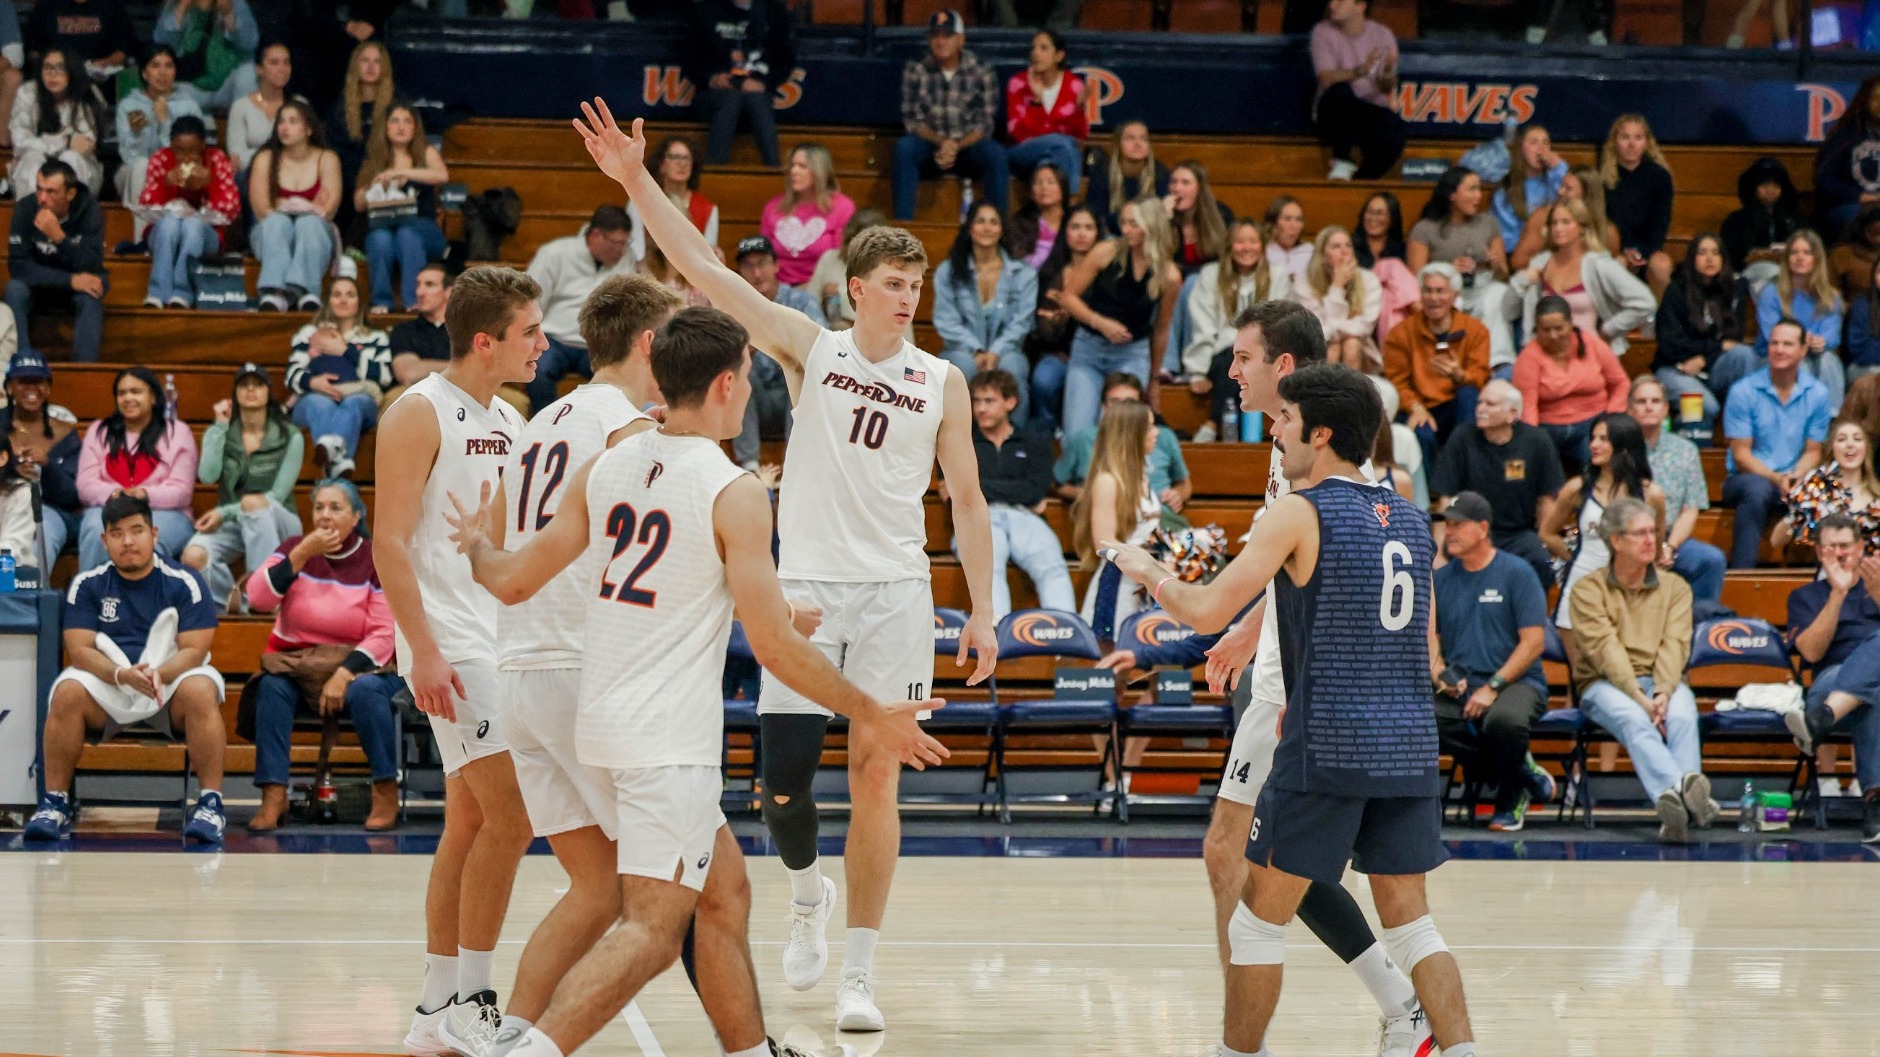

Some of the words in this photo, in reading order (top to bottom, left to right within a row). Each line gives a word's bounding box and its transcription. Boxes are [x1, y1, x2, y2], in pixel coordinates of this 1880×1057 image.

[1072, 67, 1125, 125] P
[1391, 82, 1539, 124] WAVES
[1794, 83, 1847, 141] P
[822, 372, 927, 414] PEPPERDINE
[849, 405, 889, 450] 10
[517, 440, 570, 533] 12
[599, 501, 672, 609] 22
[1380, 540, 1415, 631] 6
[102, 602, 117, 618] 86
[1032, 627, 1074, 640] WAVES
[1727, 635, 1769, 648] WAVES
[907, 682, 923, 701] 10
[1230, 758, 1251, 784] 14
[1250, 816, 1262, 842] 6
